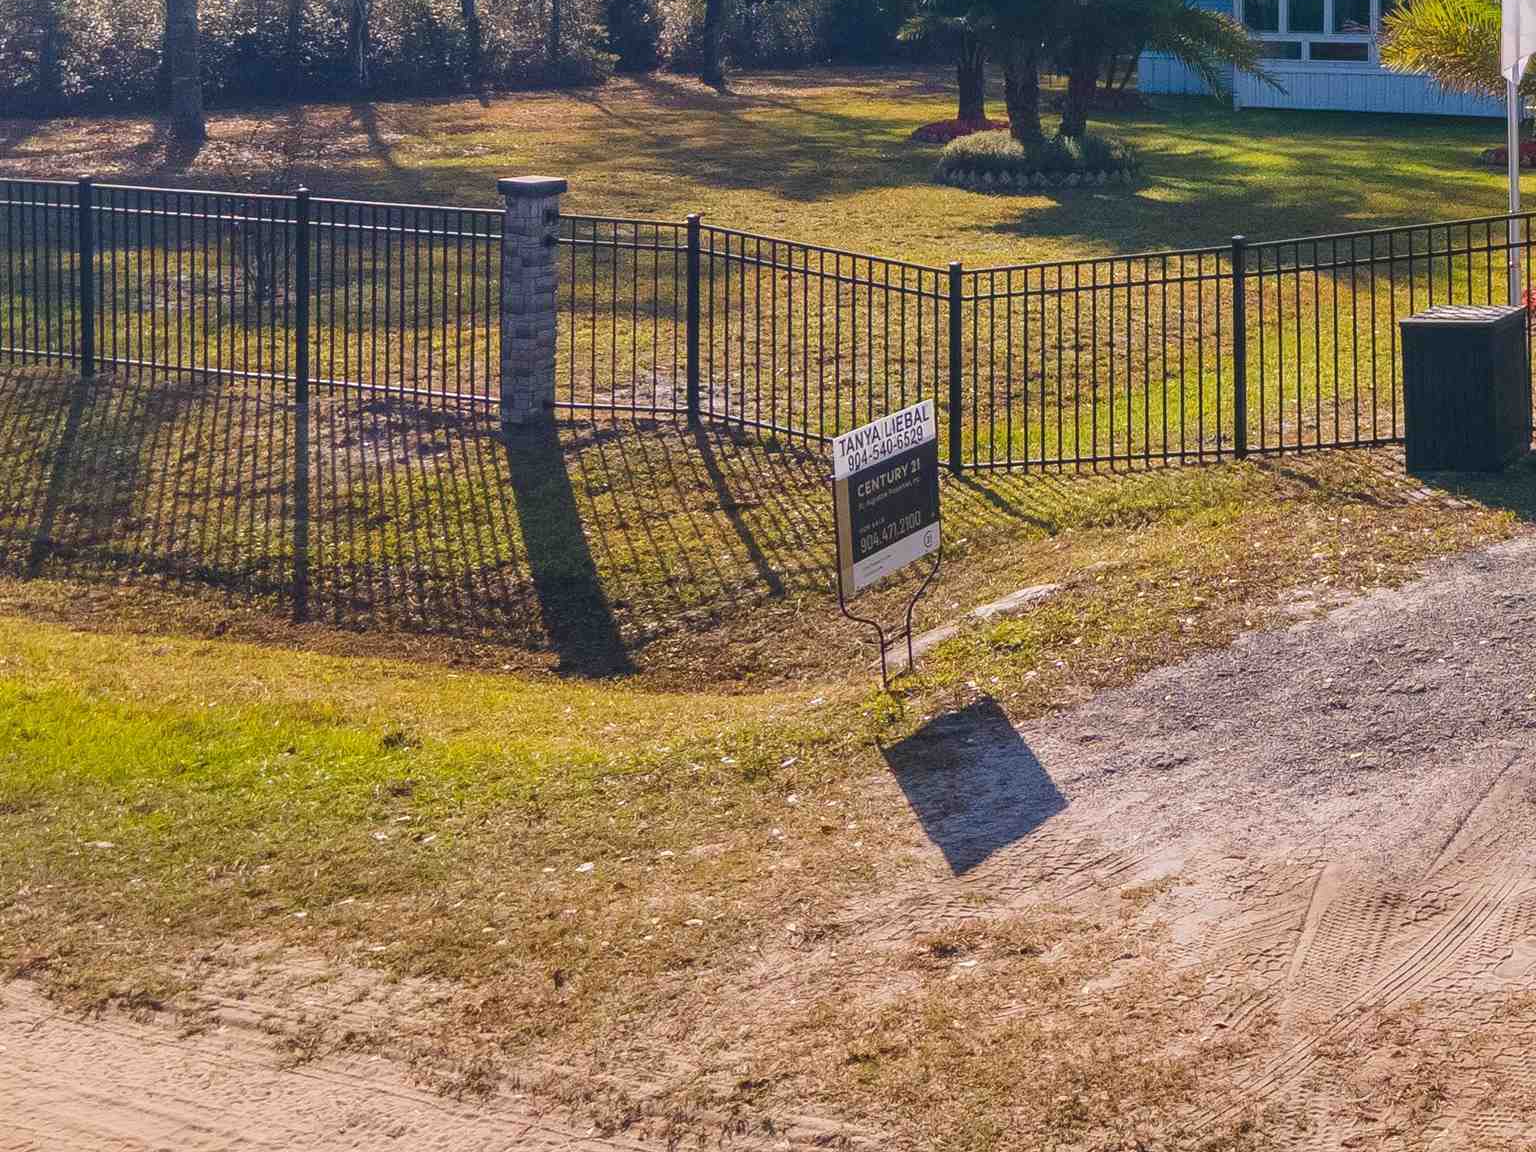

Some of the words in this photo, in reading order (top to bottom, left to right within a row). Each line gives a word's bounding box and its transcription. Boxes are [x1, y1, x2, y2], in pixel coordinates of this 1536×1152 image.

[839, 425, 881, 457] TANYA
[884, 405, 930, 437] LIEBAL
[848, 425, 923, 472] 904-540-6529
[857, 461, 909, 497] CENTURY
[910, 457, 920, 473] 21
